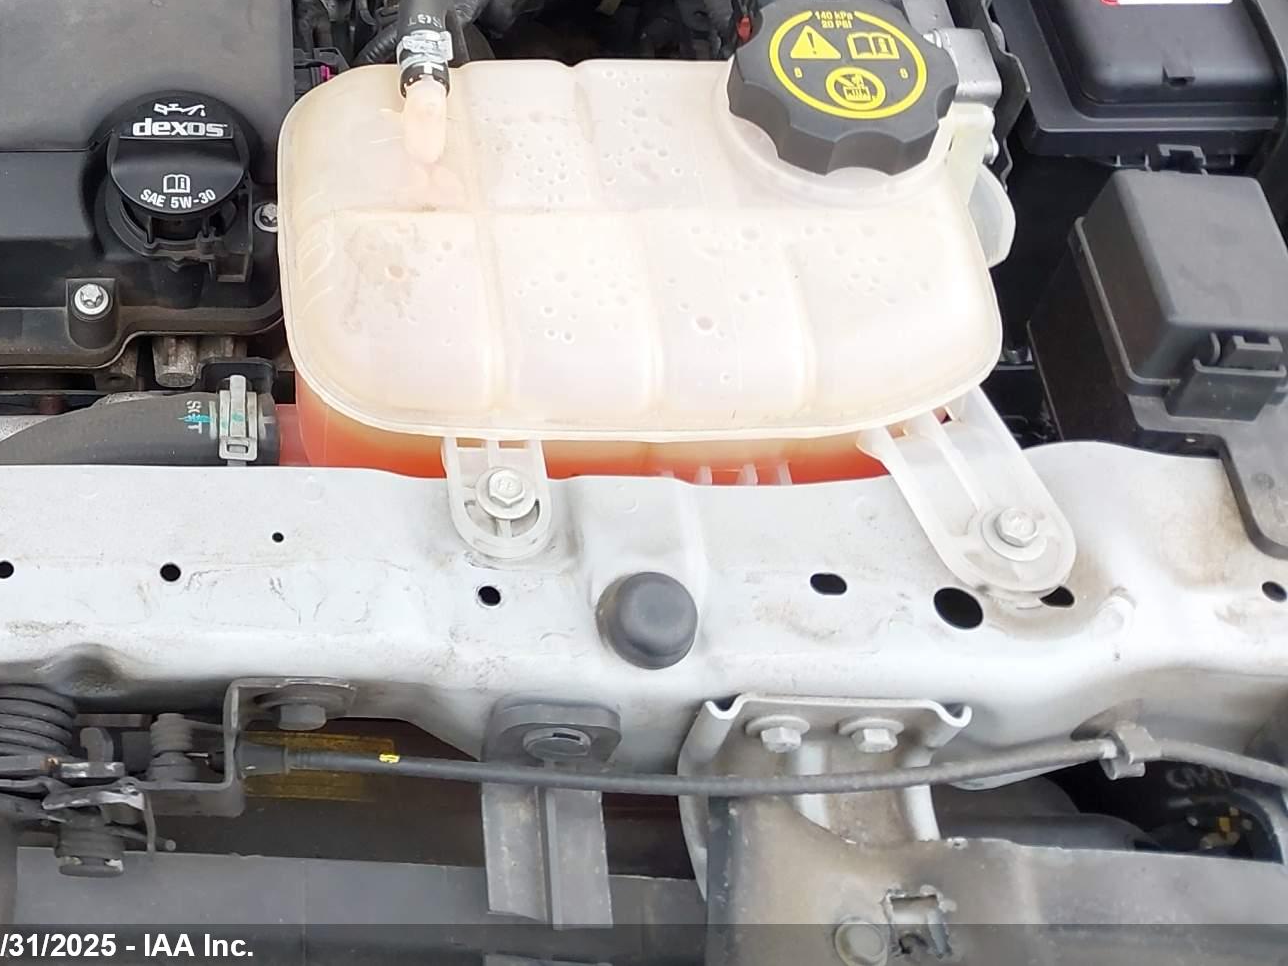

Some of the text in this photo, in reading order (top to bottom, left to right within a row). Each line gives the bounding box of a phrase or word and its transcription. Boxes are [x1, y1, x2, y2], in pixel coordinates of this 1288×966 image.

[815, 10, 853, 20] 140 kPa
[822, 19, 853, 29] 20 PSI
[132, 117, 224, 137] dexos
[140, 189, 216, 209] SAE 5W-30
